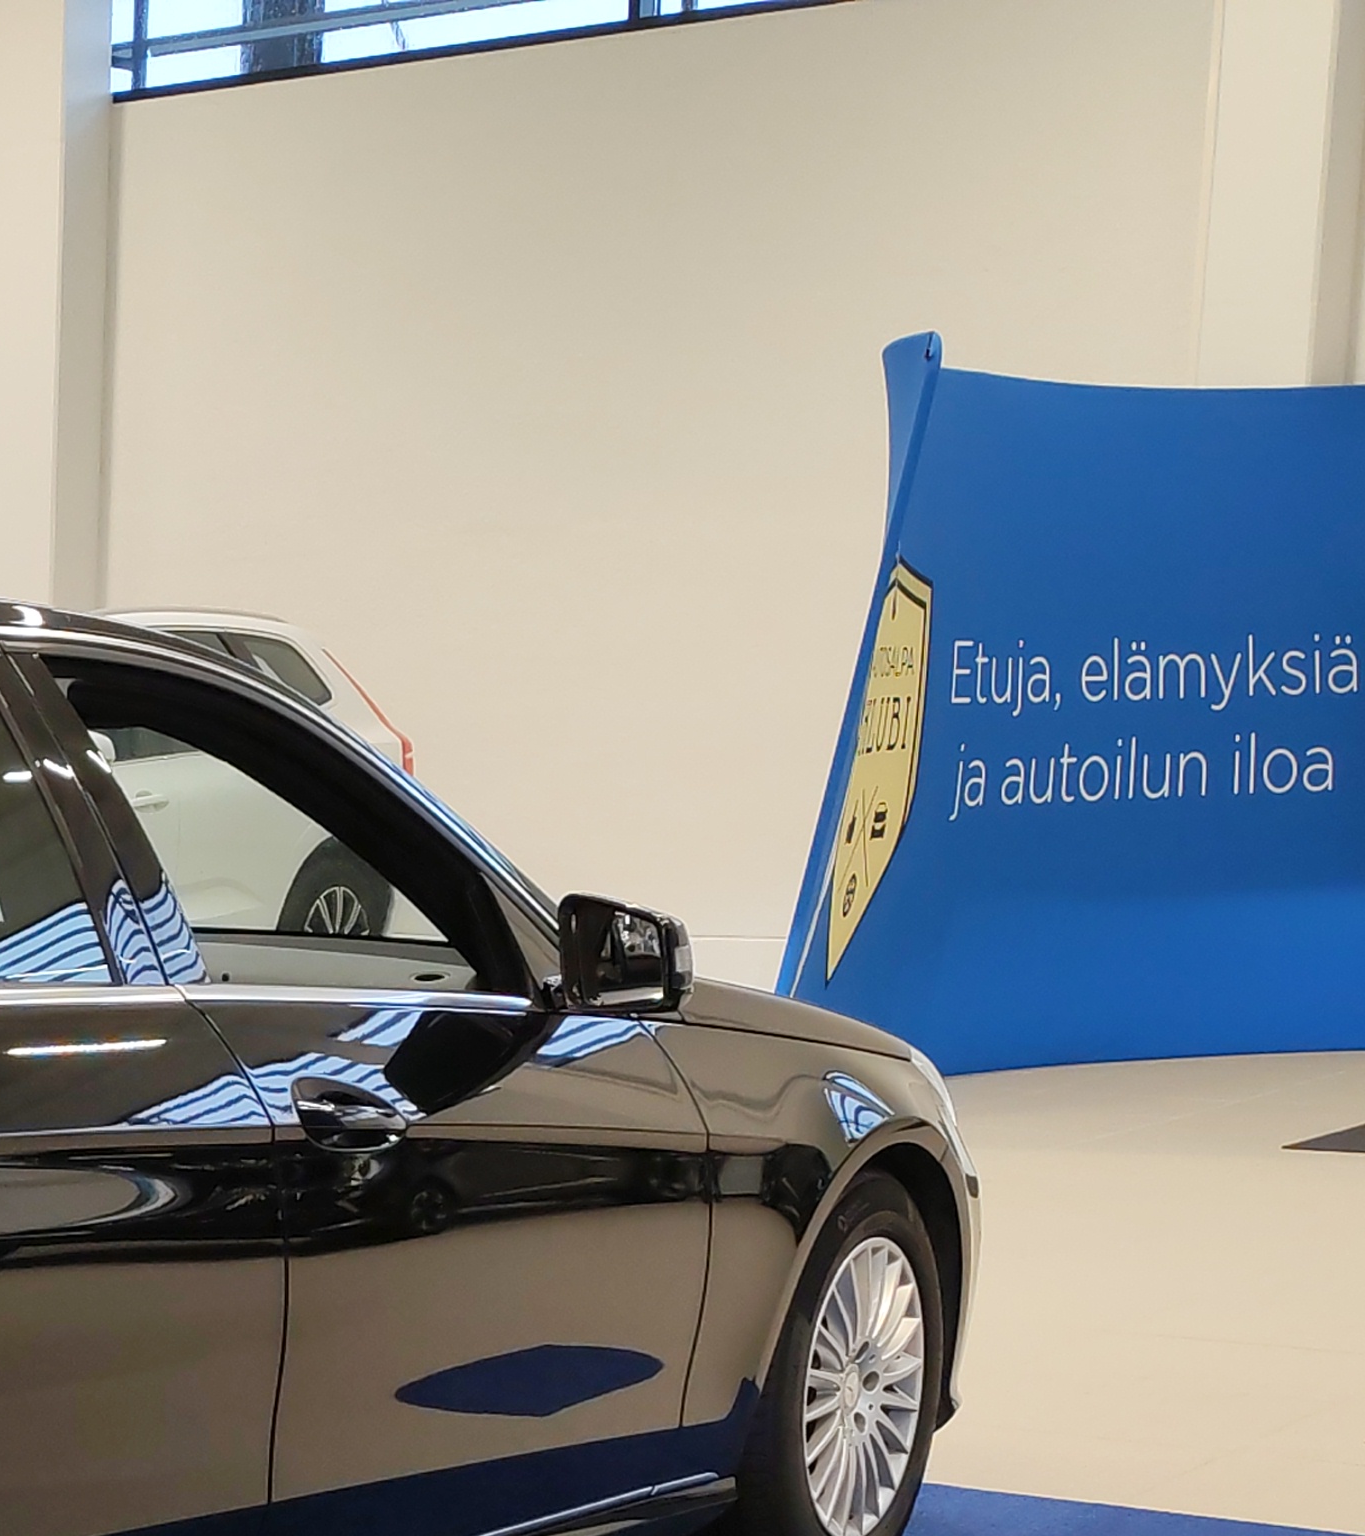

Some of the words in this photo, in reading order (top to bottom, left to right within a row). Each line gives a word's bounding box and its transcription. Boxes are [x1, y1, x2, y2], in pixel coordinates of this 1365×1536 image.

[950, 639, 1062, 717] Etuja,
[1080, 633, 1360, 711] elämyksiä
[948, 742, 987, 822] ja
[1000, 736, 1208, 806] autoilun
[1232, 731, 1335, 795] iloa
